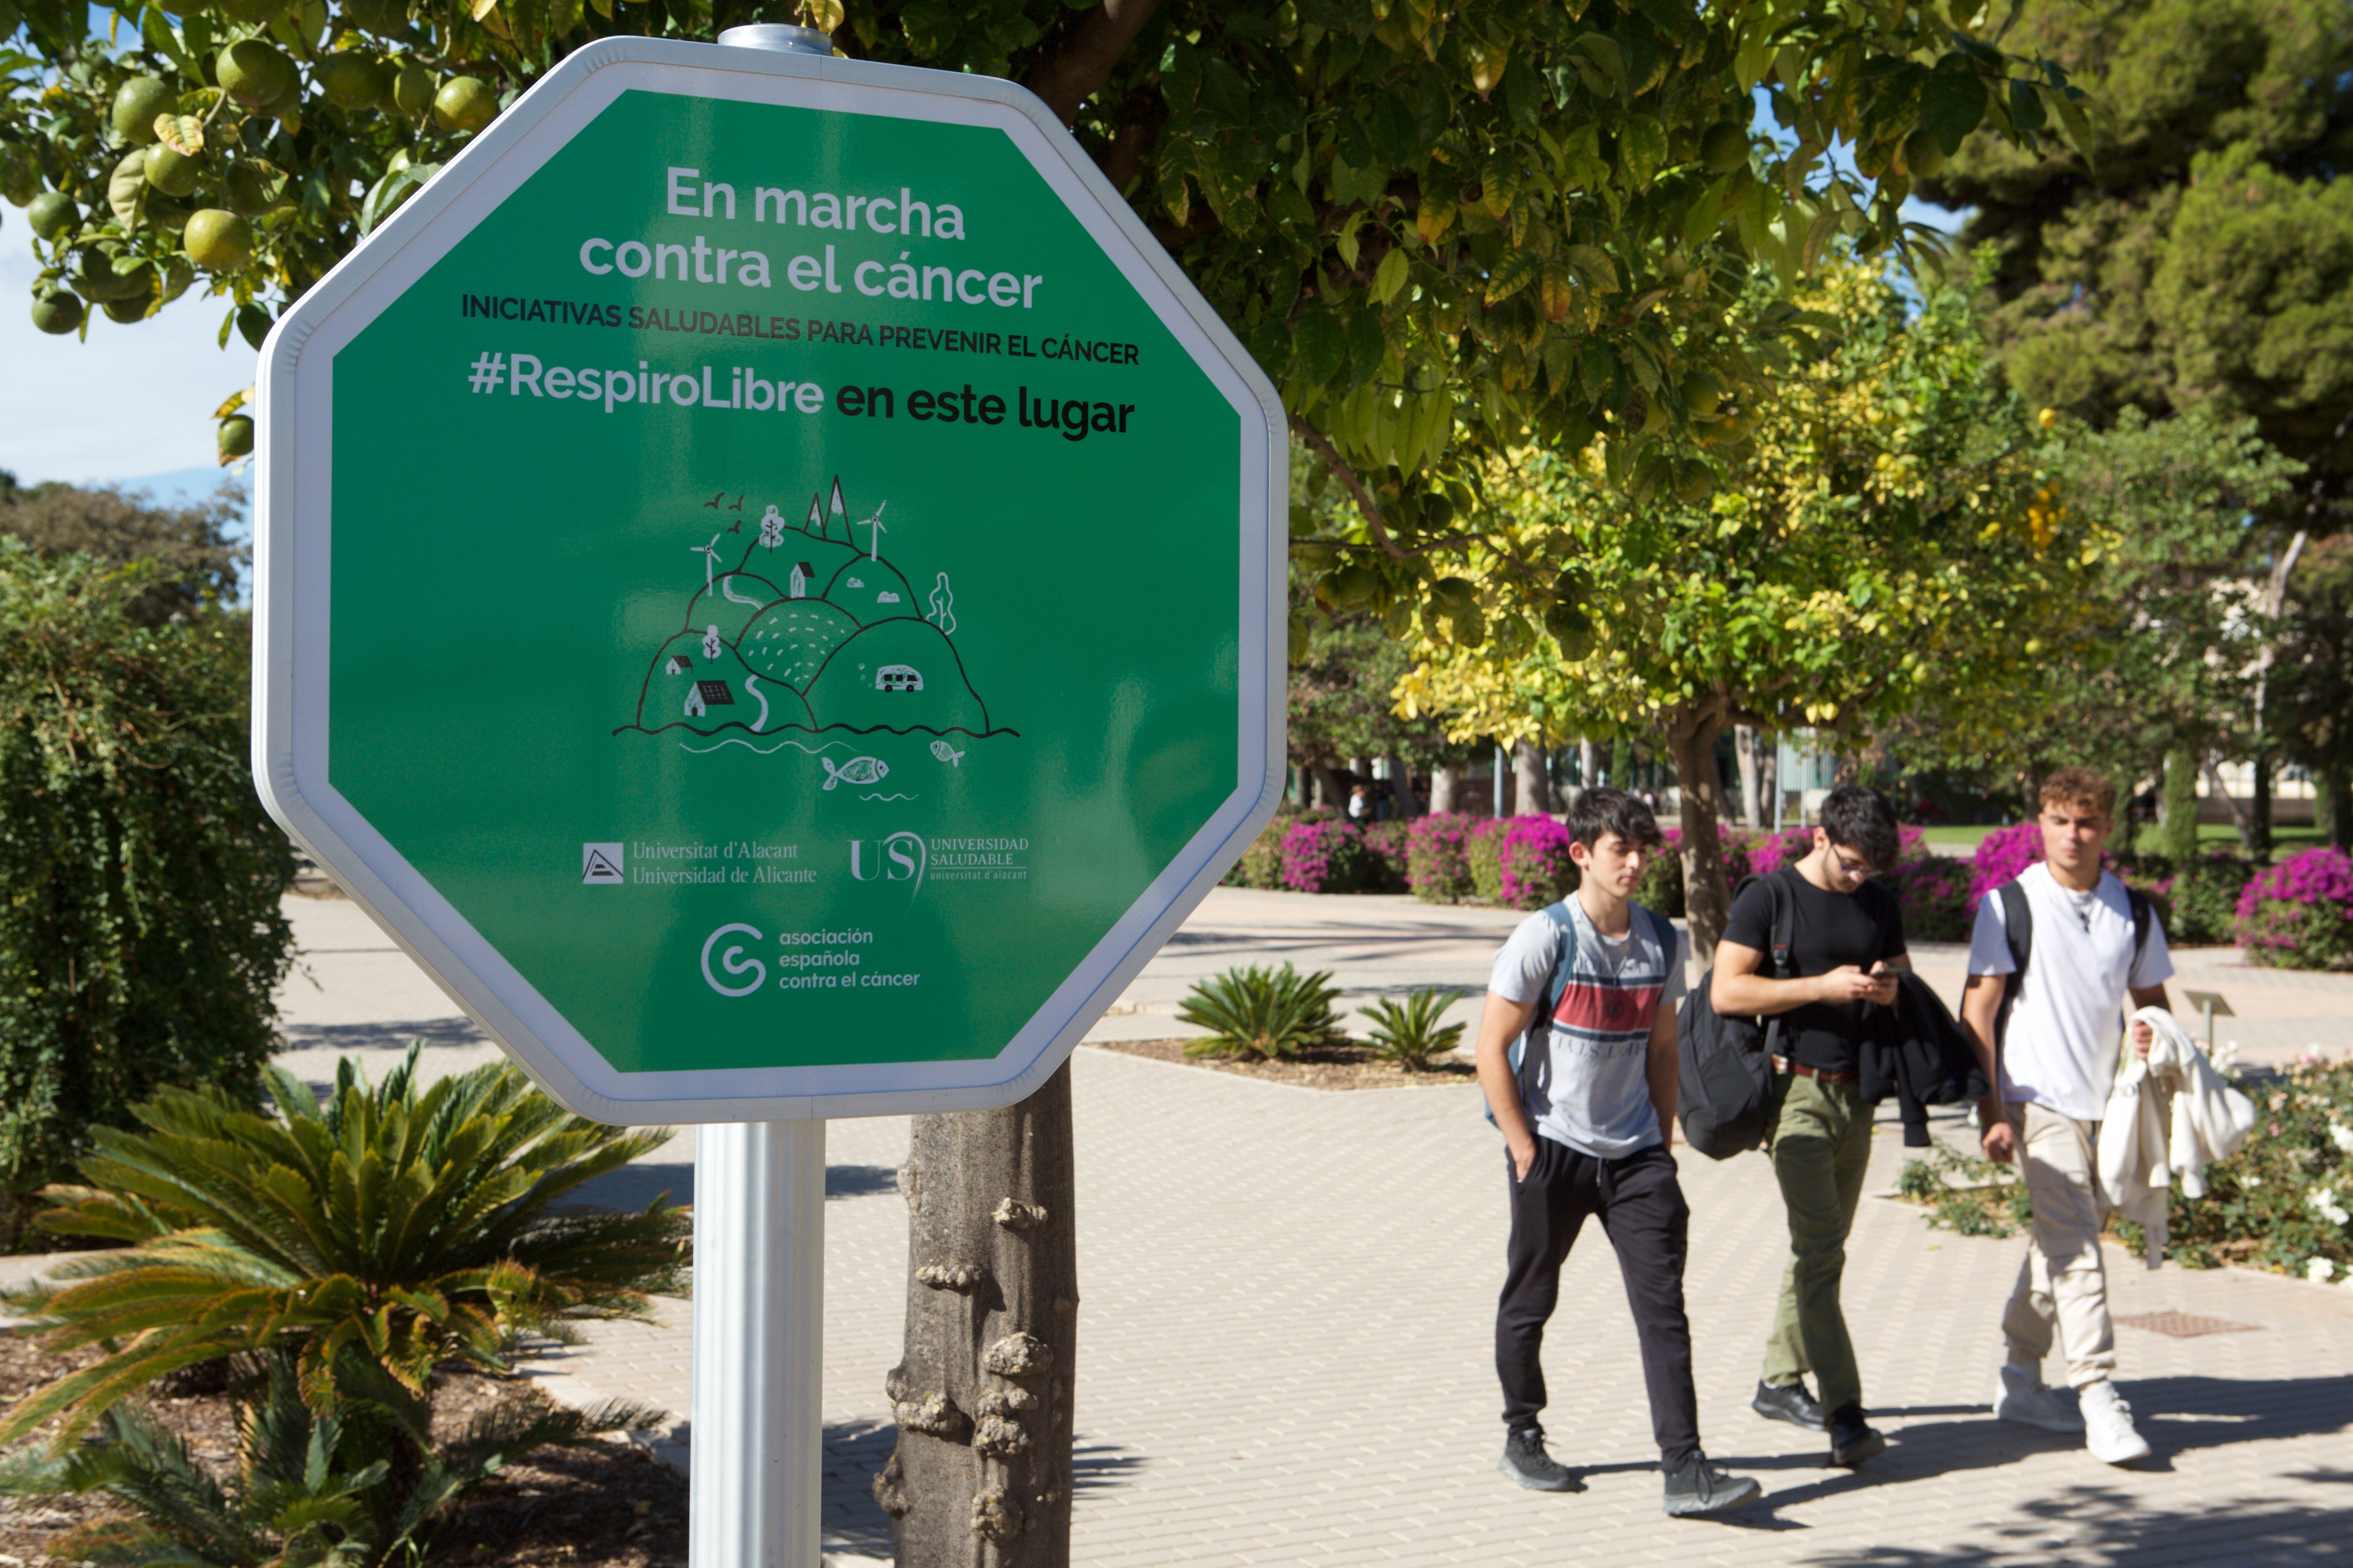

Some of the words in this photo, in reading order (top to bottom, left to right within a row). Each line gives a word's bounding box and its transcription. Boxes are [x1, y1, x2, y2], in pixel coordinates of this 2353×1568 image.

[667, 166, 735, 220] En
[755, 187, 965, 240] marcha
[579, 236, 771, 288] contra
[787, 244, 842, 293] el
[854, 251, 1043, 308] cáncer
[462, 294, 622, 327] INICIATIVAS
[628, 306, 801, 340] SALUDABLES
[808, 320, 874, 346] PARA
[880, 325, 1001, 355] PREVENIR
[1008, 334, 1037, 357] EL
[1041, 333, 1139, 365] CÁNCER
[468, 351, 825, 414] #RespiroLibre
[836, 385, 894, 418] en
[907, 384, 1006, 425] este
[1019, 386, 1135, 441] lugar
[633, 842, 718, 859] Universitat
[931, 838, 1029, 851] UNIVERSIDAD
[931, 853, 1014, 866] SALUDABLE
[633, 866, 725, 884] Universidad
[731, 866, 748, 883] de
[753, 865, 817, 883] Alicante
[931, 870, 980, 880] universitat
[779, 928, 873, 946] asociación
[779, 950, 860, 971] española
[779, 973, 837, 989] contra
[841, 971, 856, 988] el
[860, 971, 921, 988] cáncer
